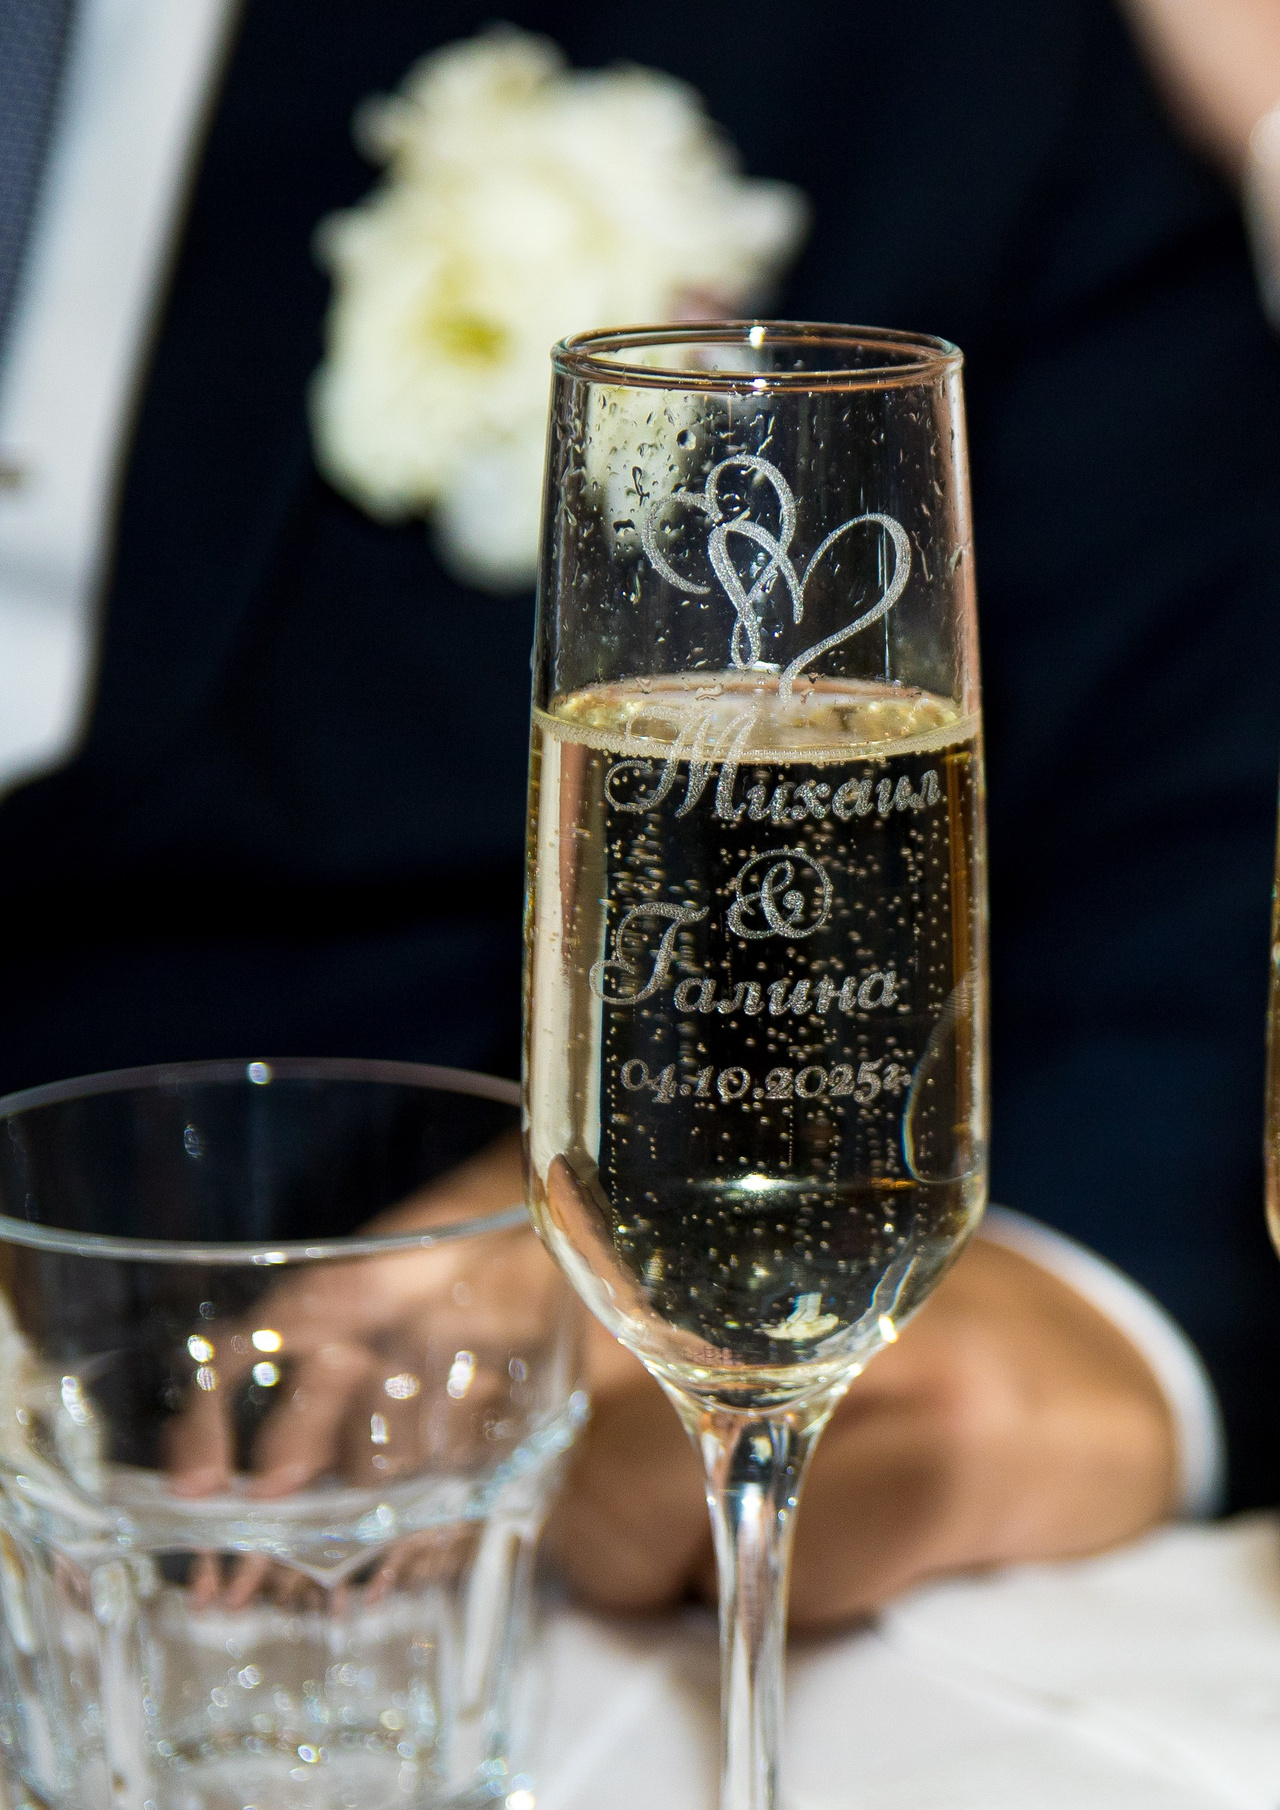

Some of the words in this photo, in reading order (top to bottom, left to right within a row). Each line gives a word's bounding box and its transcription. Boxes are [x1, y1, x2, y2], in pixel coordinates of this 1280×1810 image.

[605, 707, 941, 822] Михаил
[727, 848, 833, 940] &
[589, 901, 898, 1016] Галина
